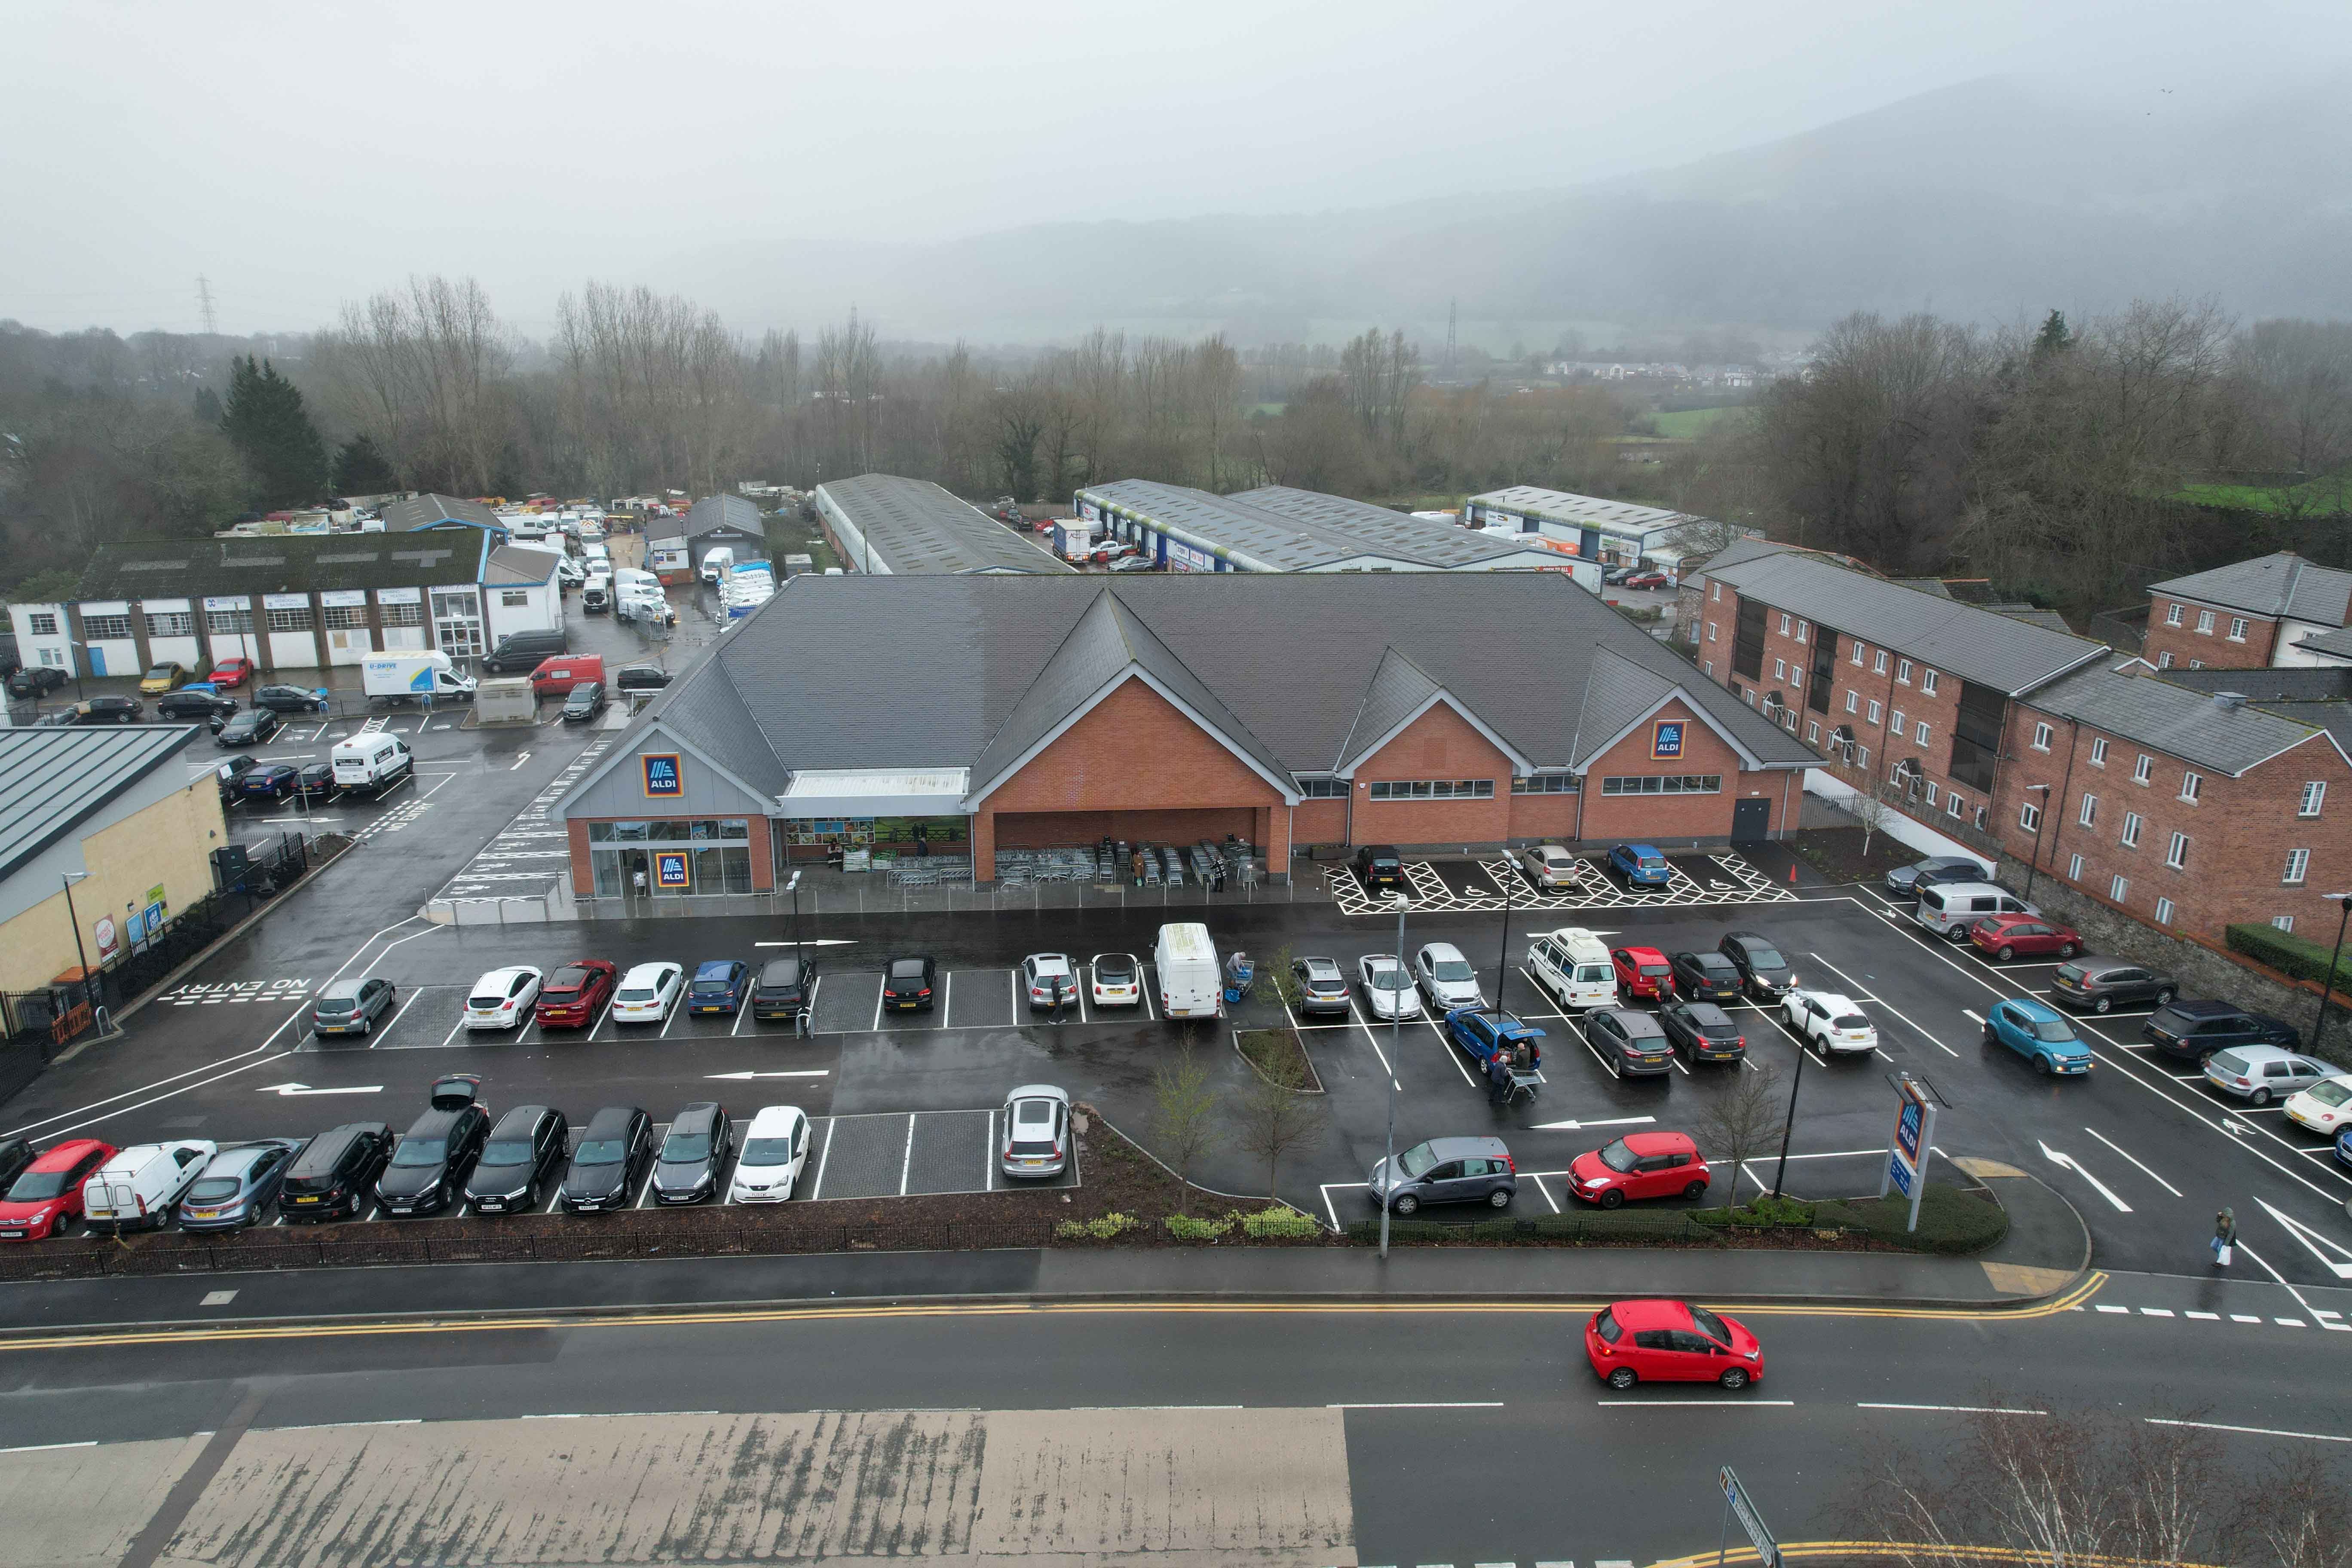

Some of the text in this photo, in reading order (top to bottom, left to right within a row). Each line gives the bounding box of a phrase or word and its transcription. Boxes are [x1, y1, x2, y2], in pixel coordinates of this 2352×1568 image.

[385, 802, 435, 831] NO ENTRY
[169, 978, 312, 995] NO ENTRY
[1899, 1124, 1917, 1151] ALDI
